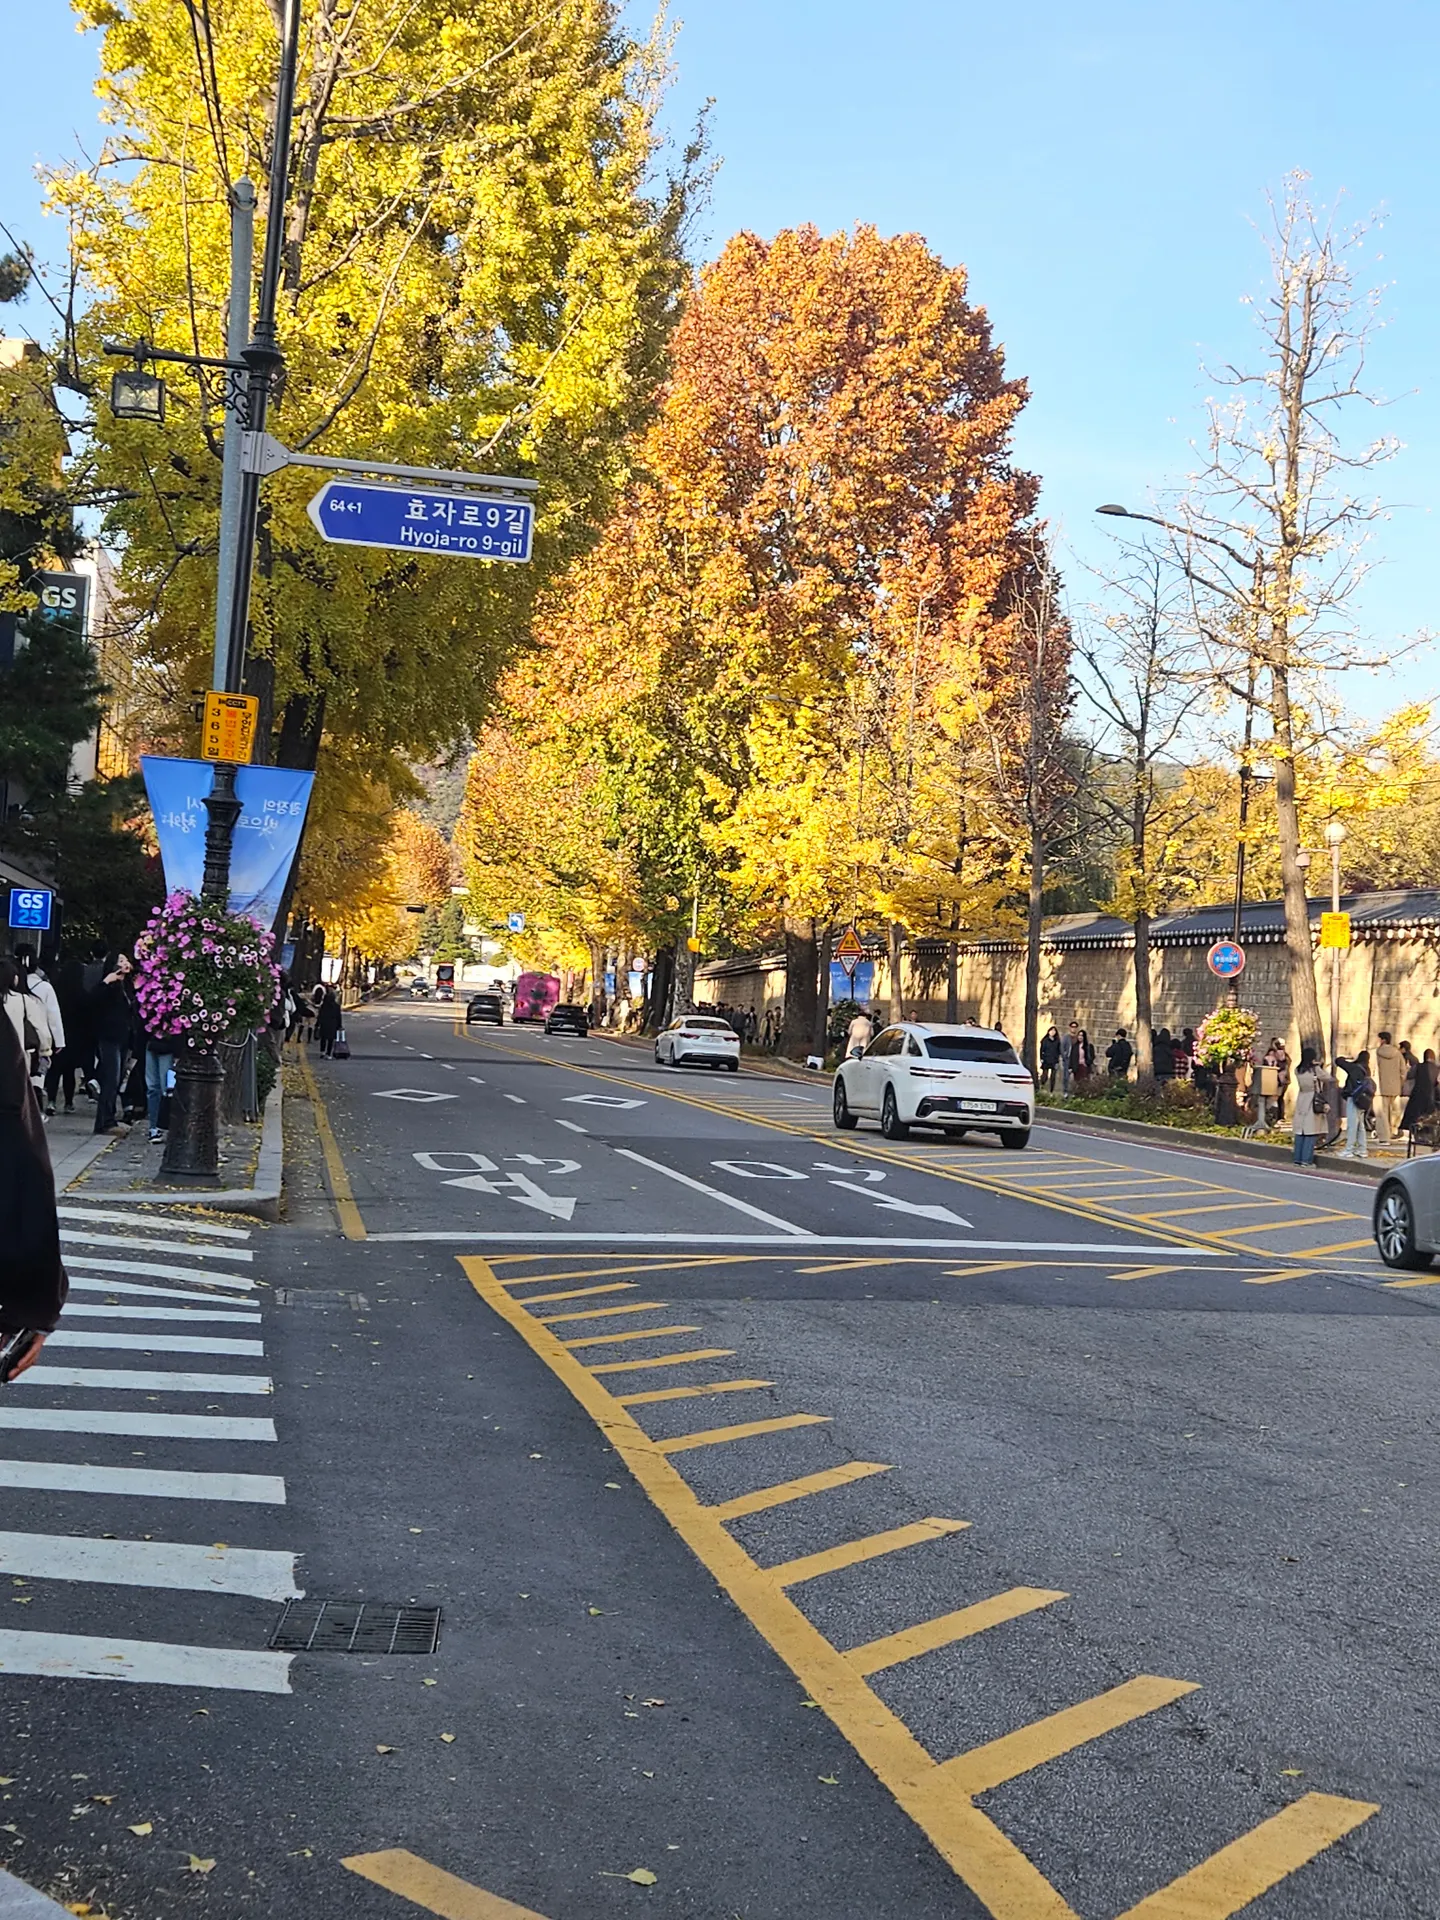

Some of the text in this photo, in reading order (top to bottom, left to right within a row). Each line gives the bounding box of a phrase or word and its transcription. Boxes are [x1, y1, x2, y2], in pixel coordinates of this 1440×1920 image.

[330, 499, 345, 512] 64
[404, 498, 525, 535] 효자로9길
[400, 526, 522, 556] Hyoja-ro 9-gil
[42, 586, 77, 609] GS
[227, 699, 246, 707] CCTV
[18, 893, 43, 909] GS
[18, 909, 42, 925] 25
